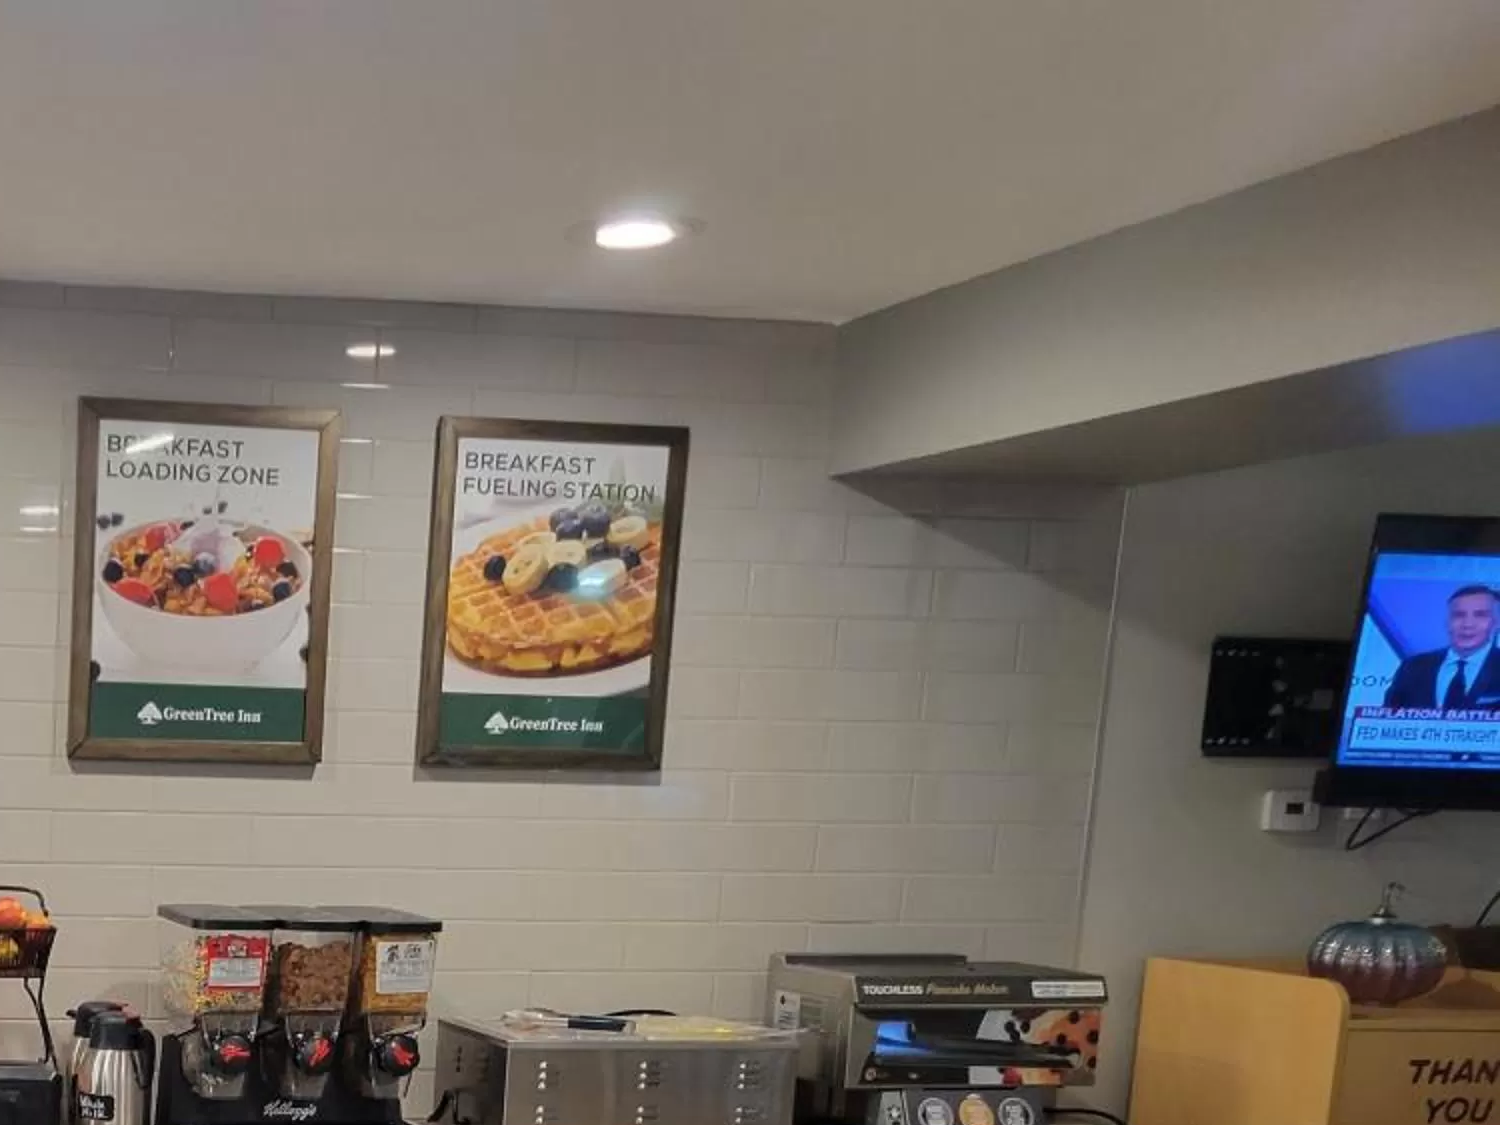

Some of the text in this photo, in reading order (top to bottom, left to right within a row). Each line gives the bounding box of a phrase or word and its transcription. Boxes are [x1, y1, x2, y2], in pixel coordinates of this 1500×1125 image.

[107, 433, 244, 460] BKFAST
[106, 459, 280, 487] LOADING ZONE
[465, 452, 596, 475] BREAKFAST
[463, 477, 656, 502] FUELING STATION
[163, 707, 261, 723] GreenTree Inn
[1361, 706, 1443, 719] INFLATION
[510, 717, 603, 733] GreenTree Inn
[1426, 1096, 1494, 1125] YOU
